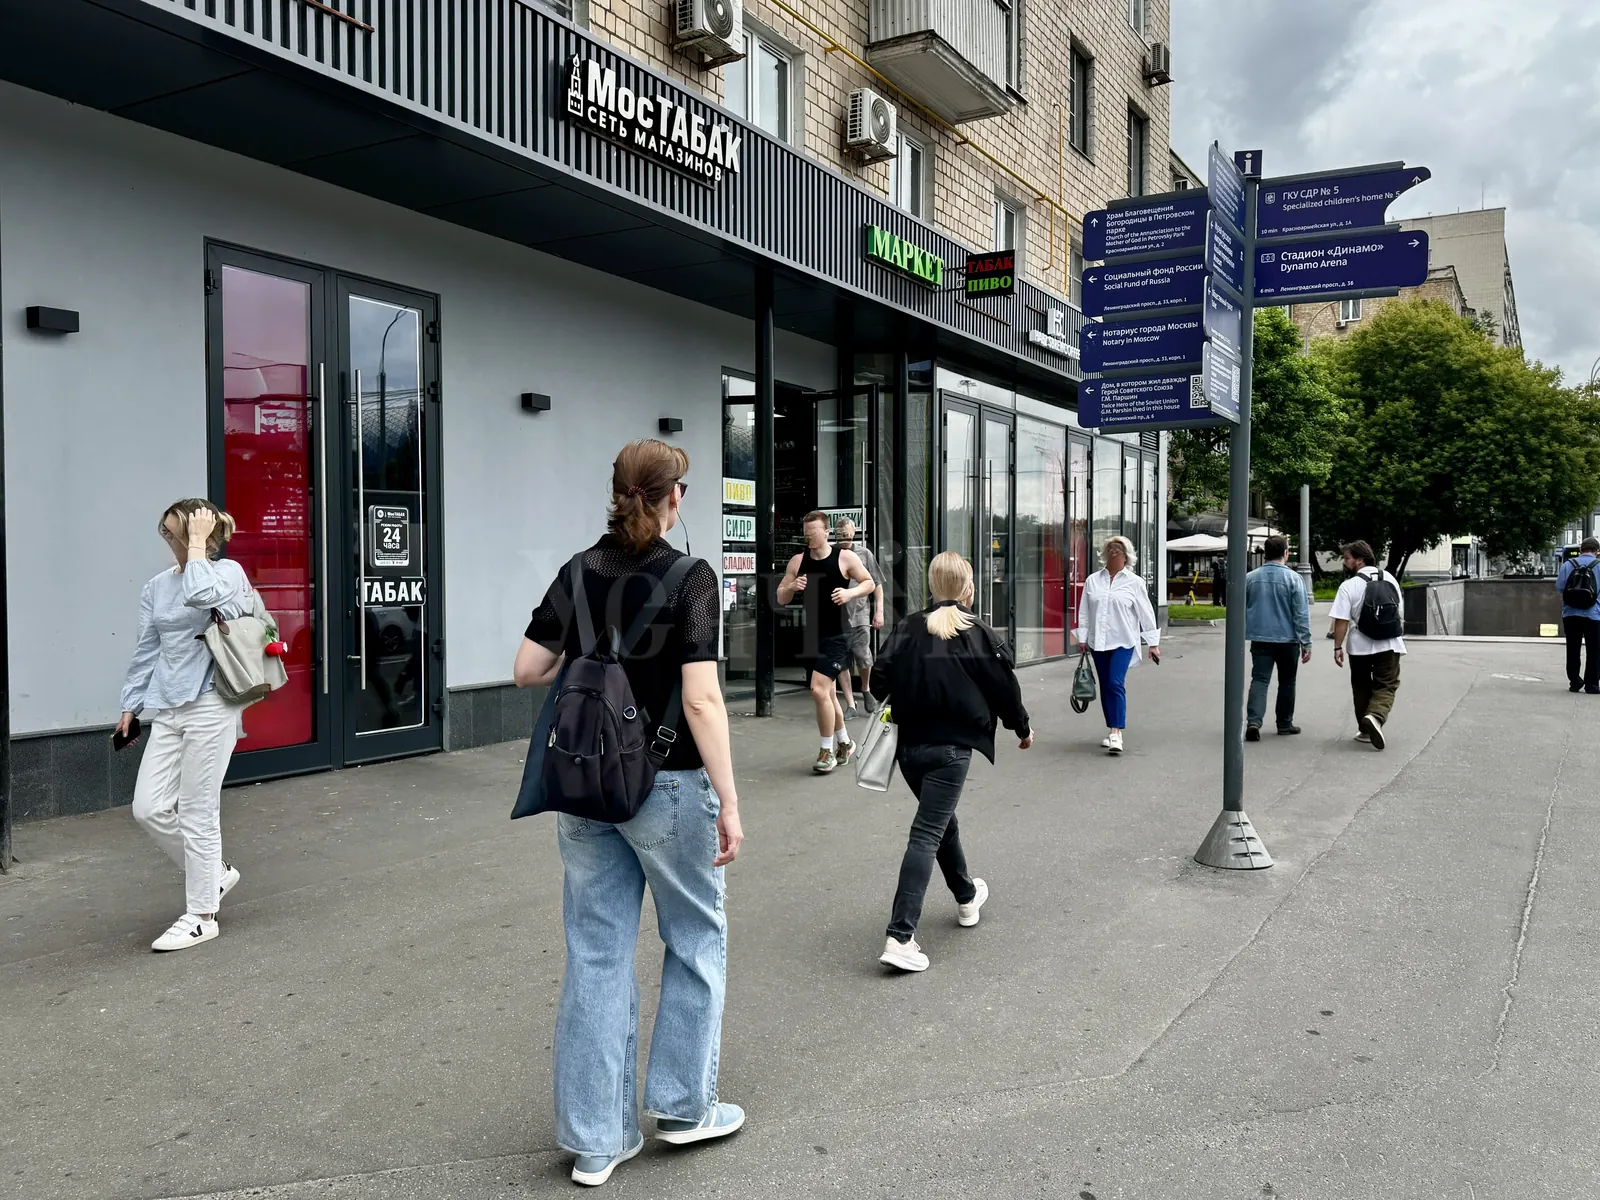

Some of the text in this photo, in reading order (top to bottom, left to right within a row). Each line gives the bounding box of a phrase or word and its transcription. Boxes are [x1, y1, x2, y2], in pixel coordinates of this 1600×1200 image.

[587, 106, 722, 181] СЕТЬ МАГАЗИНОВ
[1283, 190, 1298, 200] ГКУ
[1300, 189, 1318, 200] СДР
[1334, 186, 1339, 194] 5
[1283, 200, 1322, 211] Specialized
[1362, 193, 1383, 202] home
[1106, 205, 1173, 220] Храм Благовещения
[1106, 217, 1147, 227] Богородицы
[1154, 210, 1195, 221] Петровском
[1106, 227, 1126, 235] парке
[1140, 227, 1174, 237] Annunciation
[1282, 223, 1329, 233] Красноармейская
[869, 225, 944, 286] МАРКЕТ
[1281, 243, 1383, 262] Стадион «Динамо»
[967, 255, 1013, 274] ТАБАК
[1281, 258, 1347, 273] Dynamo Arena
[1104, 264, 1203, 281] Социальный фонд России
[968, 276, 1012, 293] ПИВО
[1104, 277, 1170, 290] Social Fund of Russia
[1280, 283, 1321, 292] Ленинградский
[1104, 303, 1140, 311] Ленинградский
[1103, 321, 1198, 337] Нотариус города Москвы
[1103, 338, 1125, 346] Notary
[1134, 335, 1160, 343] Moscow
[1102, 359, 1138, 367] Ленинградский
[1121, 380, 1147, 388] котором
[726, 482, 752, 501] ПИВО
[383, 528, 400, 542] 24
[726, 519, 752, 539] СИДР
[724, 556, 754, 571] СЛАДКОЕ
[364, 582, 423, 602] ТАБАК
